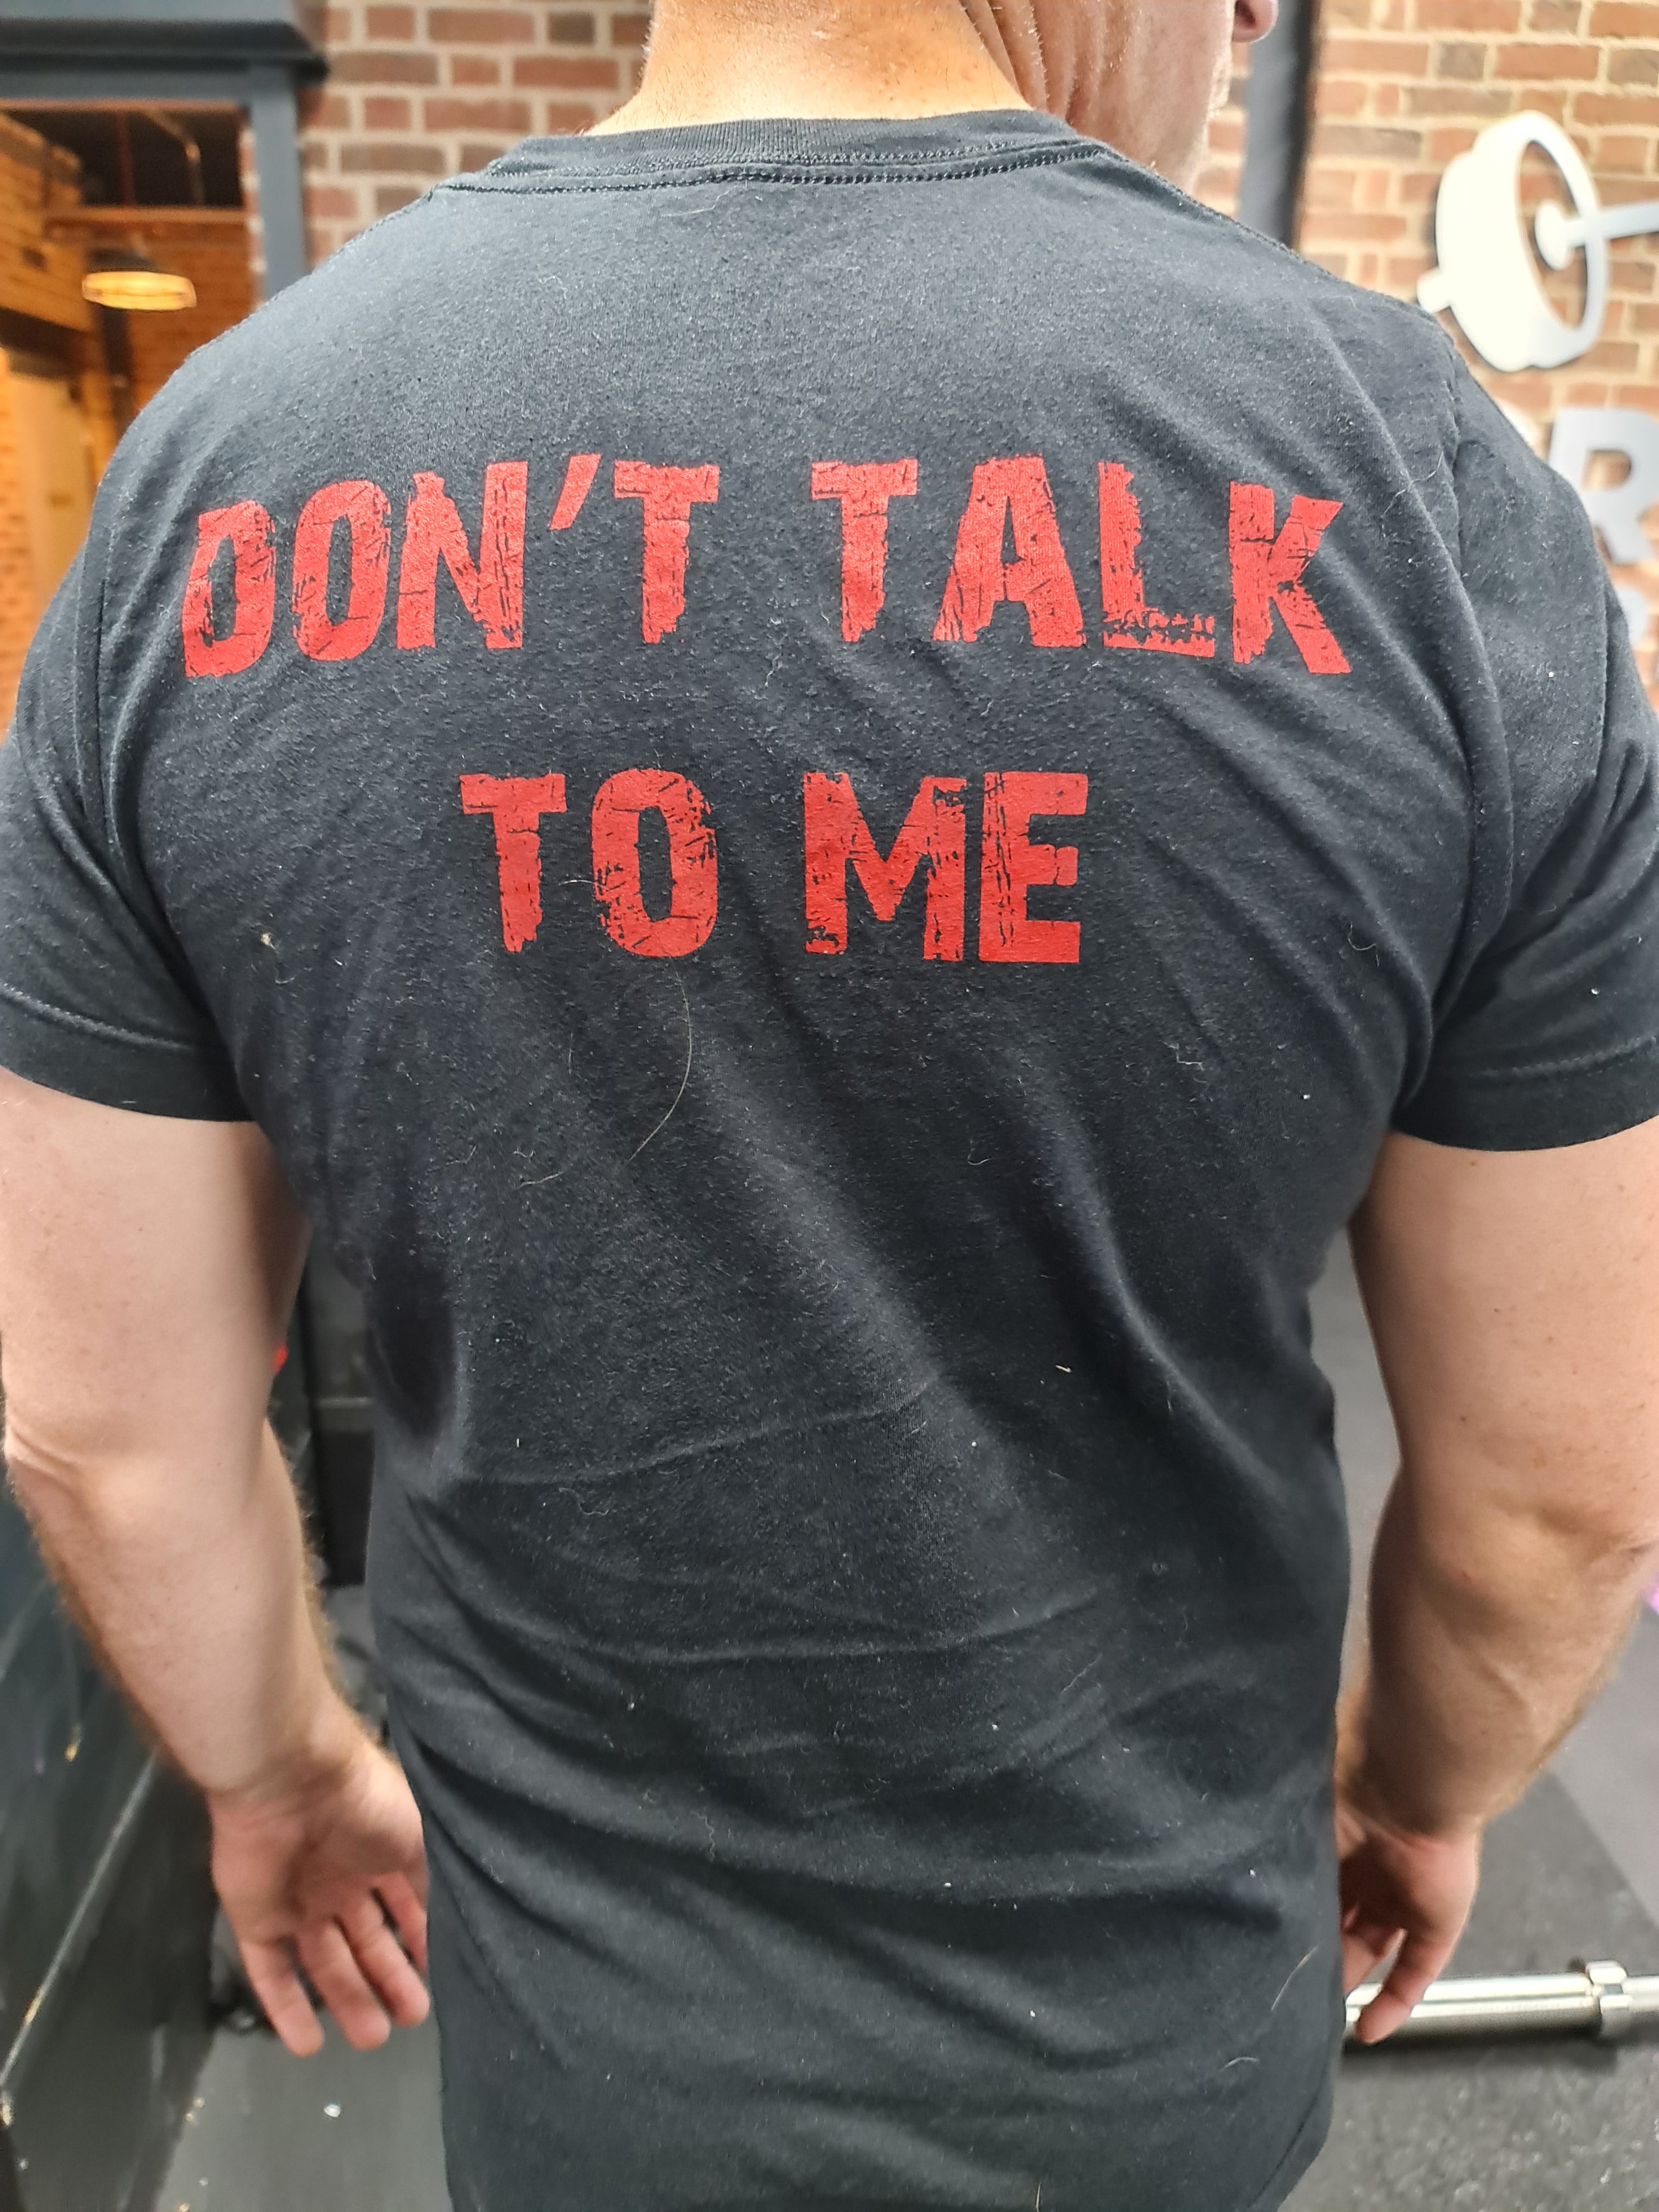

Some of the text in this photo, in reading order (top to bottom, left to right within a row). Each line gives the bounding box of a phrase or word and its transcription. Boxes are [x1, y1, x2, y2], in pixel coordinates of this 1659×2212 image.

[182, 455, 1351, 678] DON'T TALK
[461, 770, 1089, 964] TO ME
